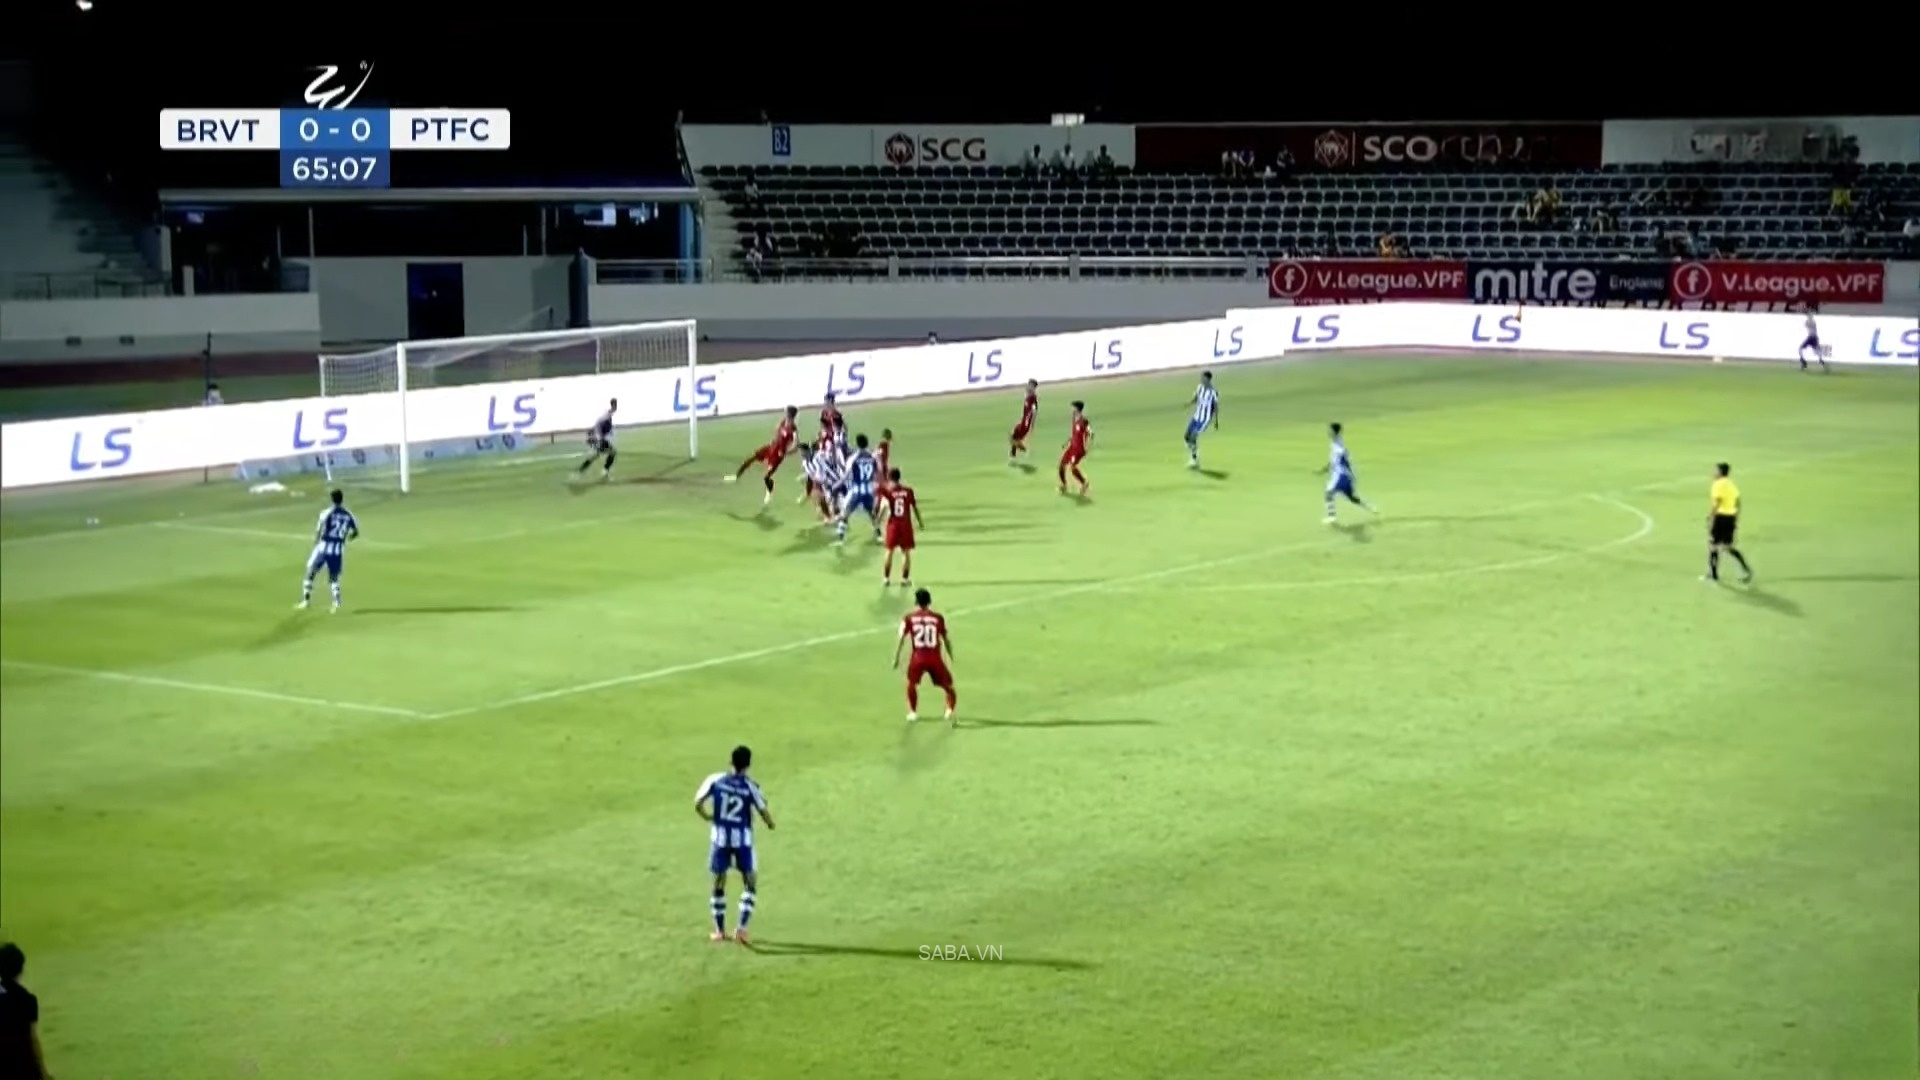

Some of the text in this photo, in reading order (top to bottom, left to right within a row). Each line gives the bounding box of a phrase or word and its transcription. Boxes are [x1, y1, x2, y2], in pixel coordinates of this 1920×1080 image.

[774, 128, 789, 153] B2
[921, 138, 987, 162] SCG
[1316, 270, 1466, 293] V.League.VPF
[1475, 261, 1597, 299] mitre
[1722, 273, 1880, 296] V.League.VPF
[1213, 326, 1243, 358] LS
[1292, 314, 1340, 344] LS
[1471, 314, 1522, 343] LS
[1659, 321, 1710, 350] LS
[1869, 327, 1919, 359] LS
[967, 349, 1002, 383] LS
[1092, 340, 1122, 370] LS
[828, 361, 865, 396] LS
[673, 375, 716, 413] LS
[487, 394, 537, 431] LS
[292, 408, 348, 449] LS
[70, 427, 132, 471] LS
[857, 462, 874, 481] 19
[894, 497, 905, 518] 6
[913, 623, 937, 649] 20
[720, 791, 744, 823] 12
